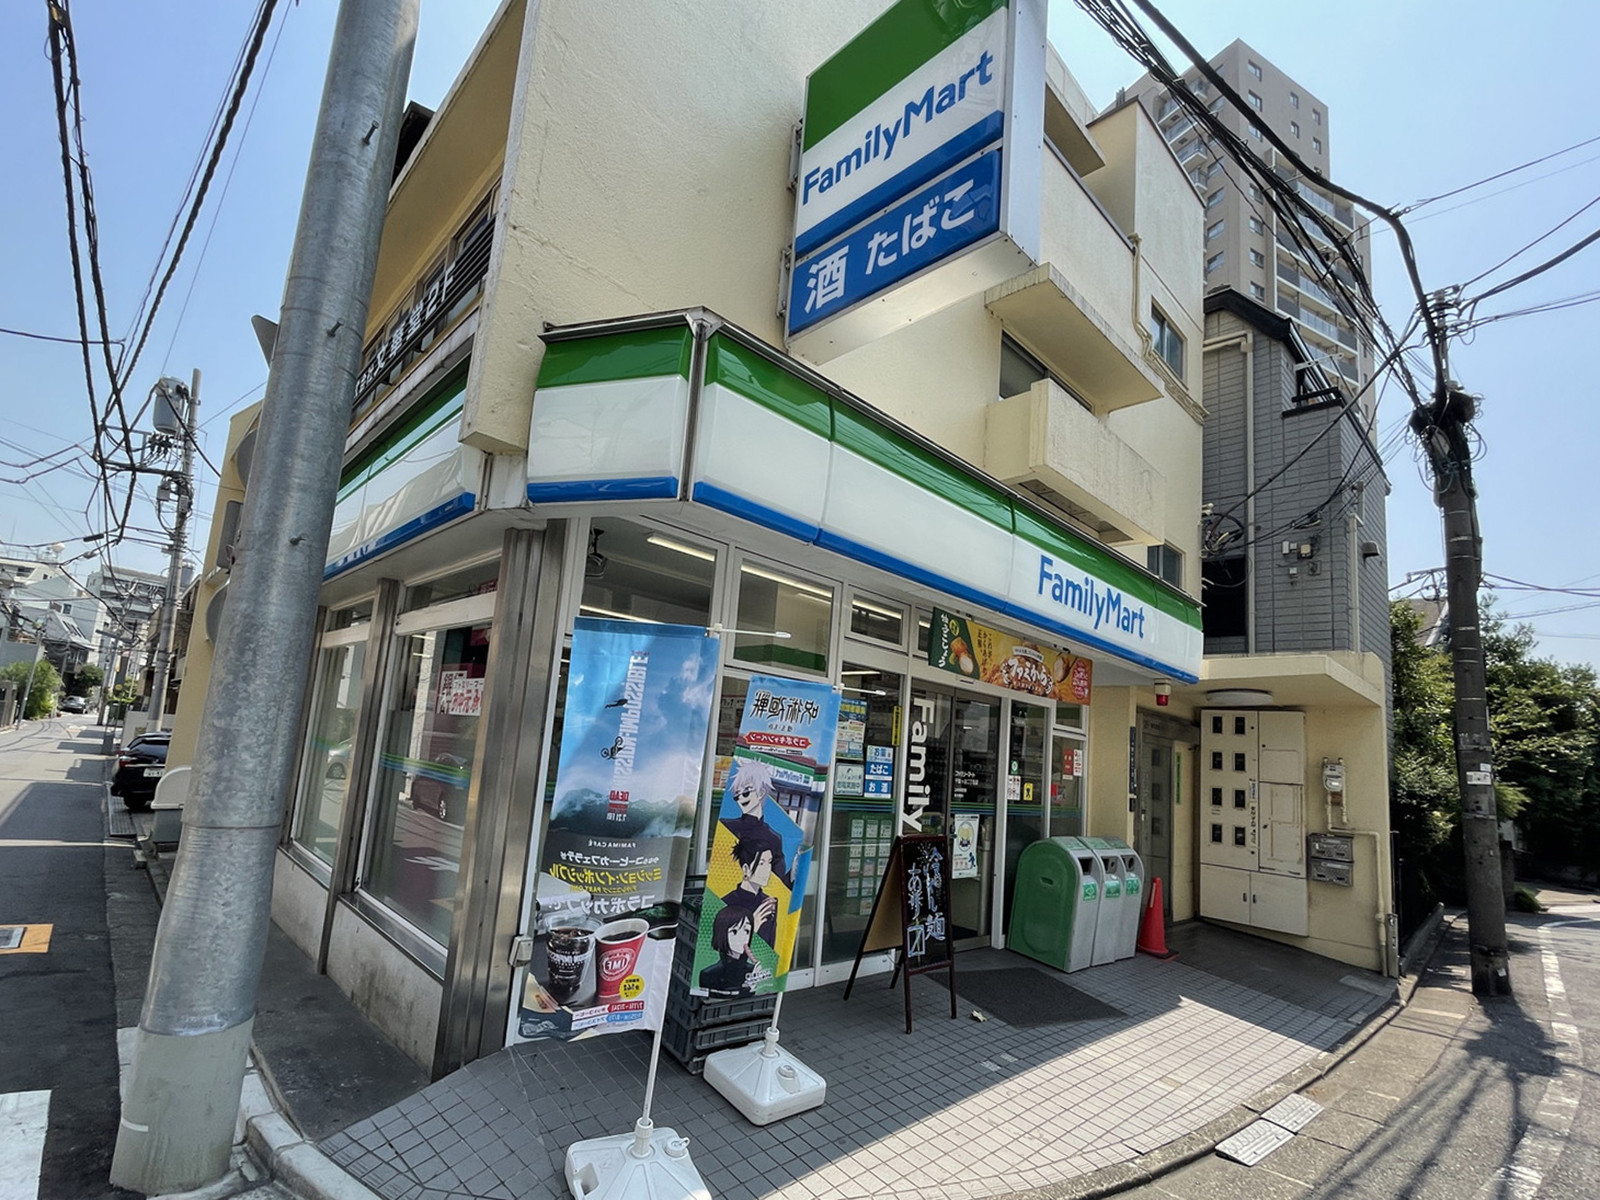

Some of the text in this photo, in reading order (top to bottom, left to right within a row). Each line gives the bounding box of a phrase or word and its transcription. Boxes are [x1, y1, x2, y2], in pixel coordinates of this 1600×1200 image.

[802, 50, 994, 206] FamilyMart
[425, 261, 456, 320] 2F
[804, 179, 975, 314] 酒 たばこ
[1038, 554, 1146, 639] FamilyMart
[869, 764, 890, 775] たばこ
[903, 698, 935, 833] Family
